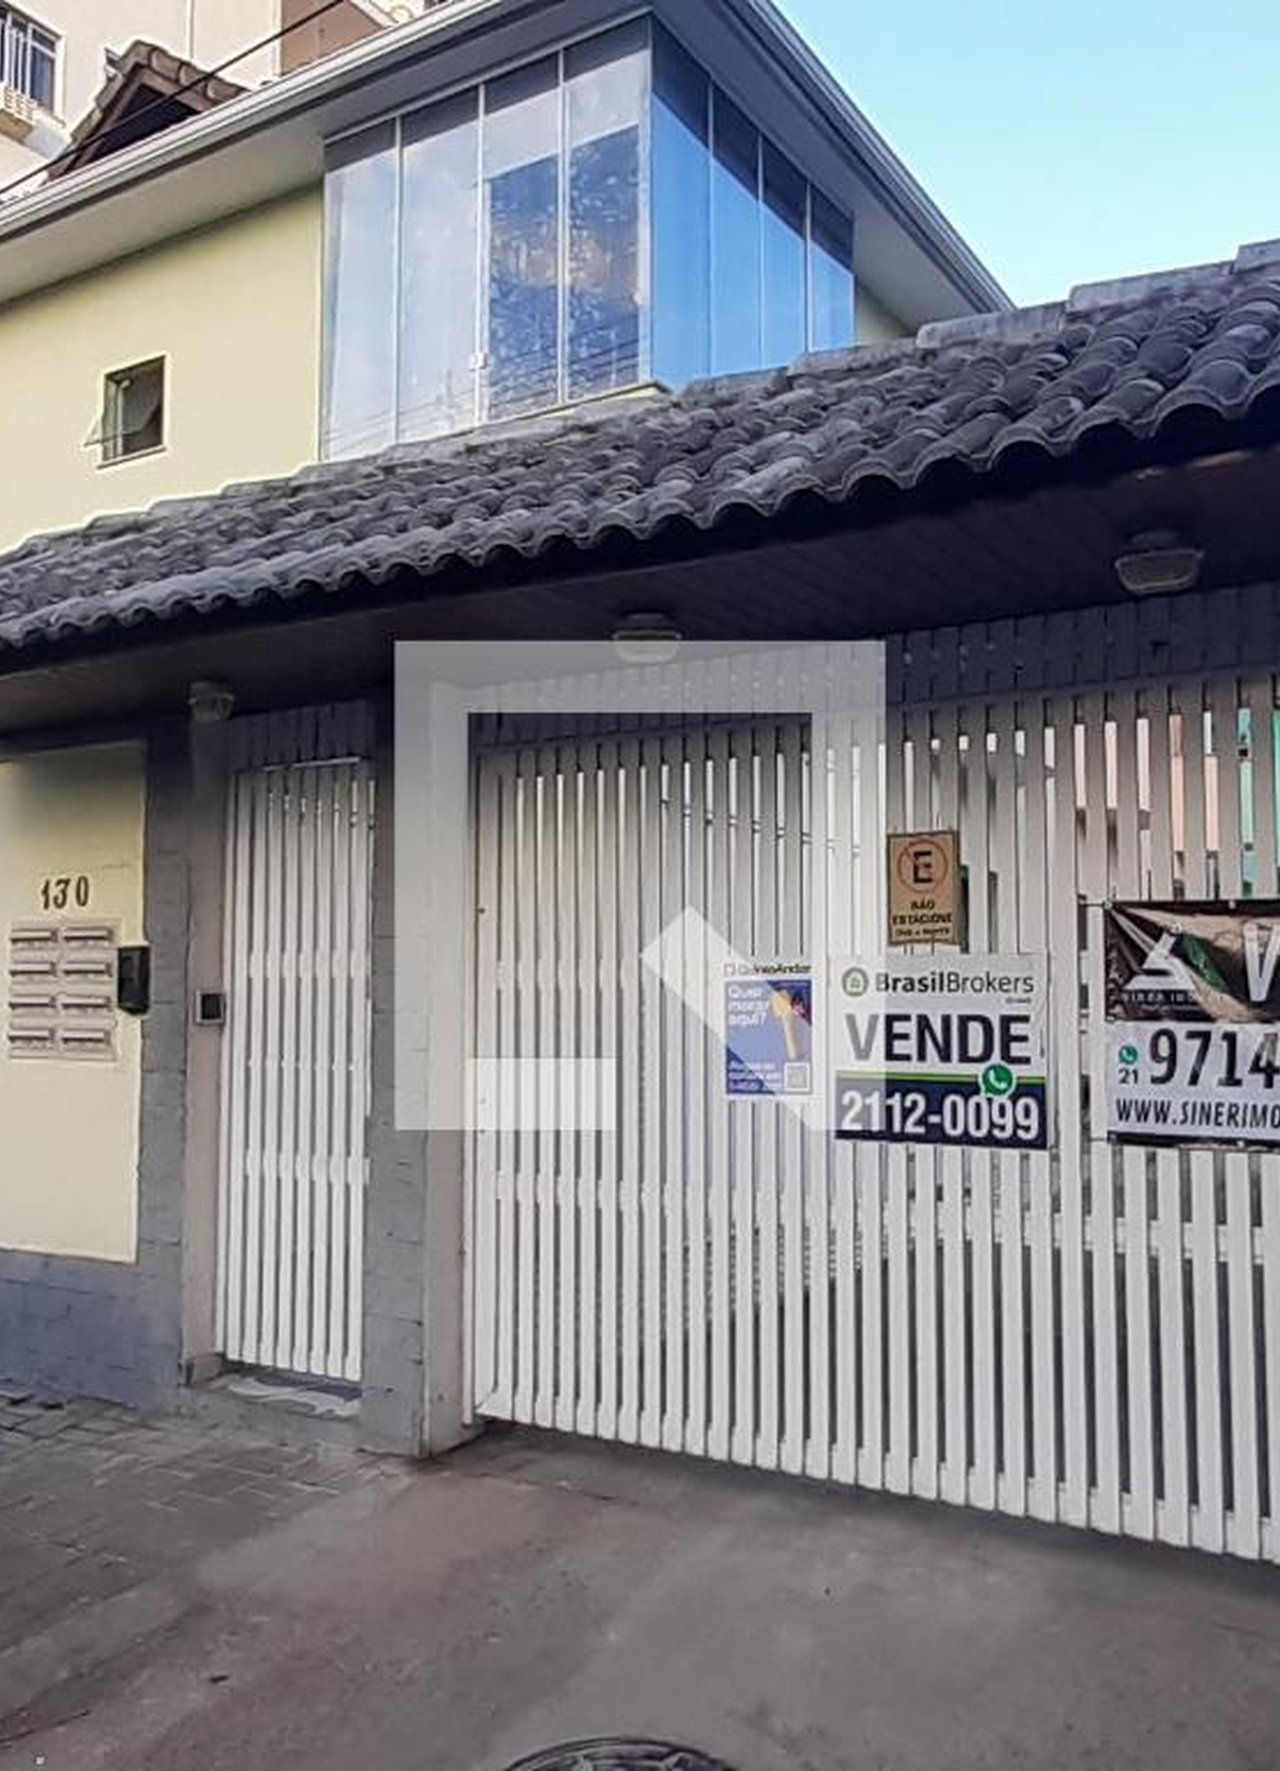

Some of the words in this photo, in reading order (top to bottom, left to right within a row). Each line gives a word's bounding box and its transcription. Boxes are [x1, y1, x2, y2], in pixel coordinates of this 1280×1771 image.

[913, 850, 932, 883] E
[41, 876, 89, 910] 130
[876, 971, 1034, 994] BrasilBrokers
[845, 1013, 1032, 1065] VENDE
[1119, 1068, 1139, 1085] 21
[840, 1090, 1039, 1140] 2112-0099
